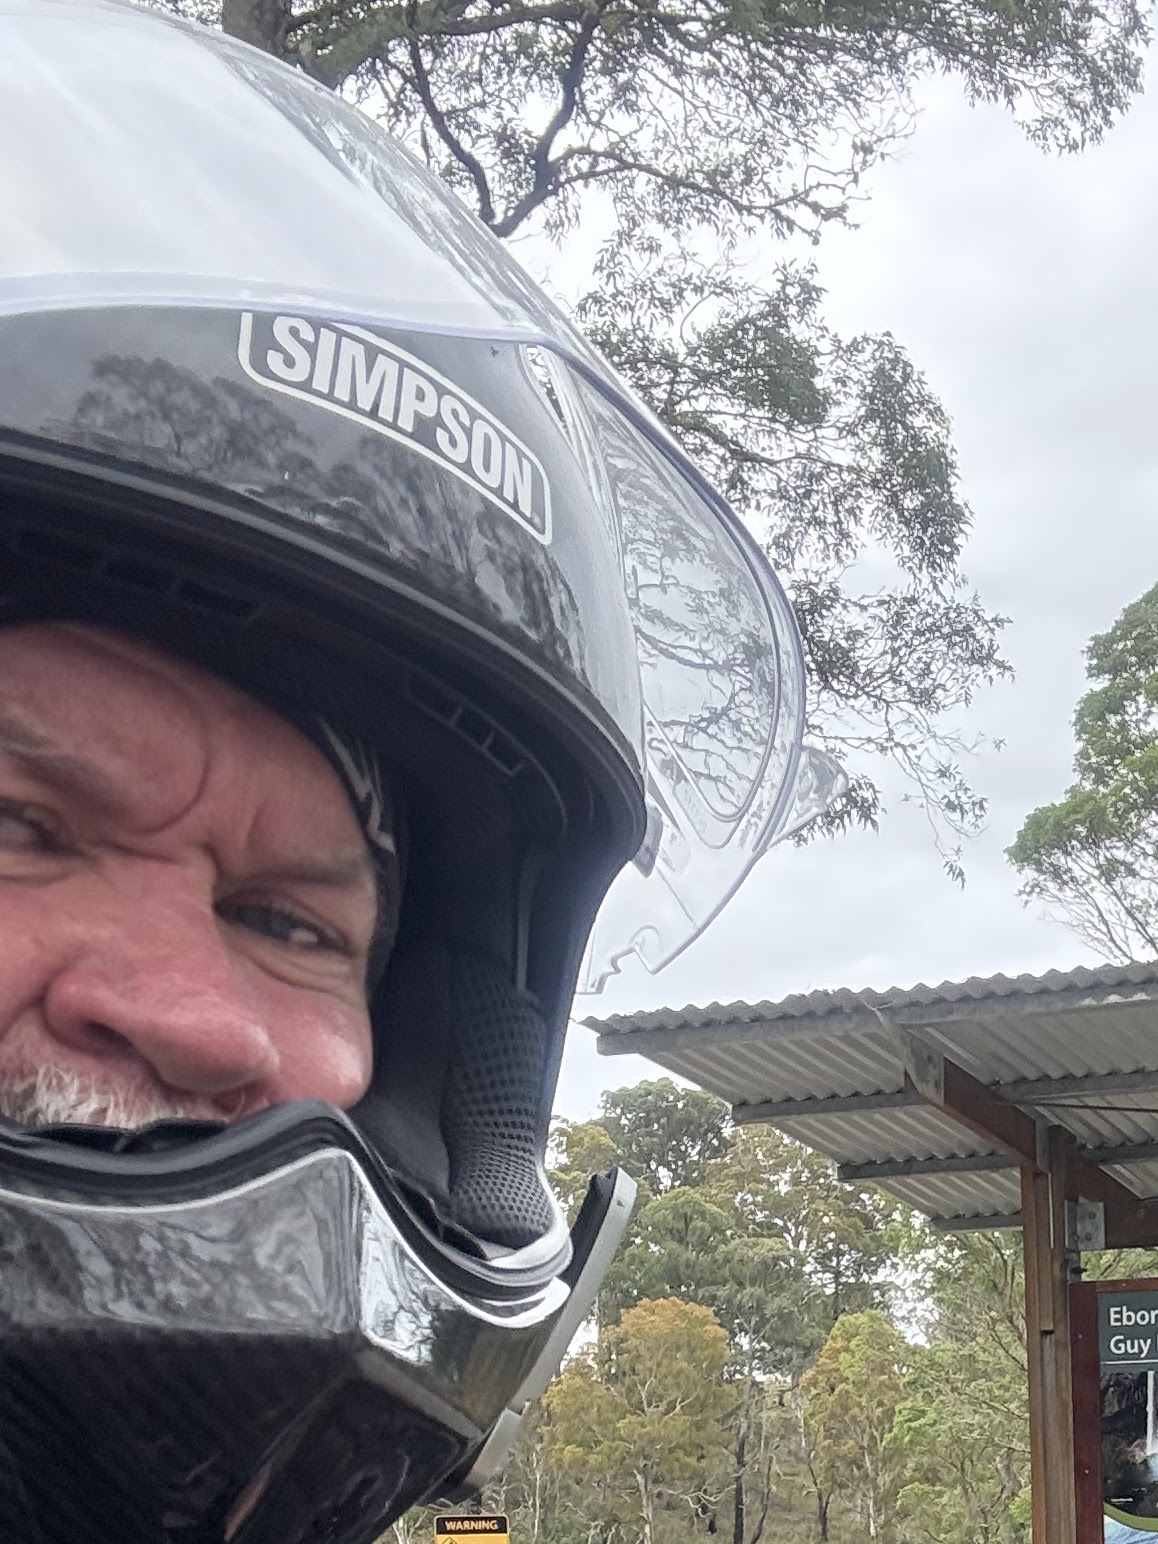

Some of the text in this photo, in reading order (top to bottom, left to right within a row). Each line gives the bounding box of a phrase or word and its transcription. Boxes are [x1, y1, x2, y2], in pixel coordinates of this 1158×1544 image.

[267, 315, 532, 519] SIMPSON
[1109, 1305, 1158, 1327] Ebor
[1109, 1334, 1151, 1358] Guy
[444, 1520, 499, 1531] WARNING
